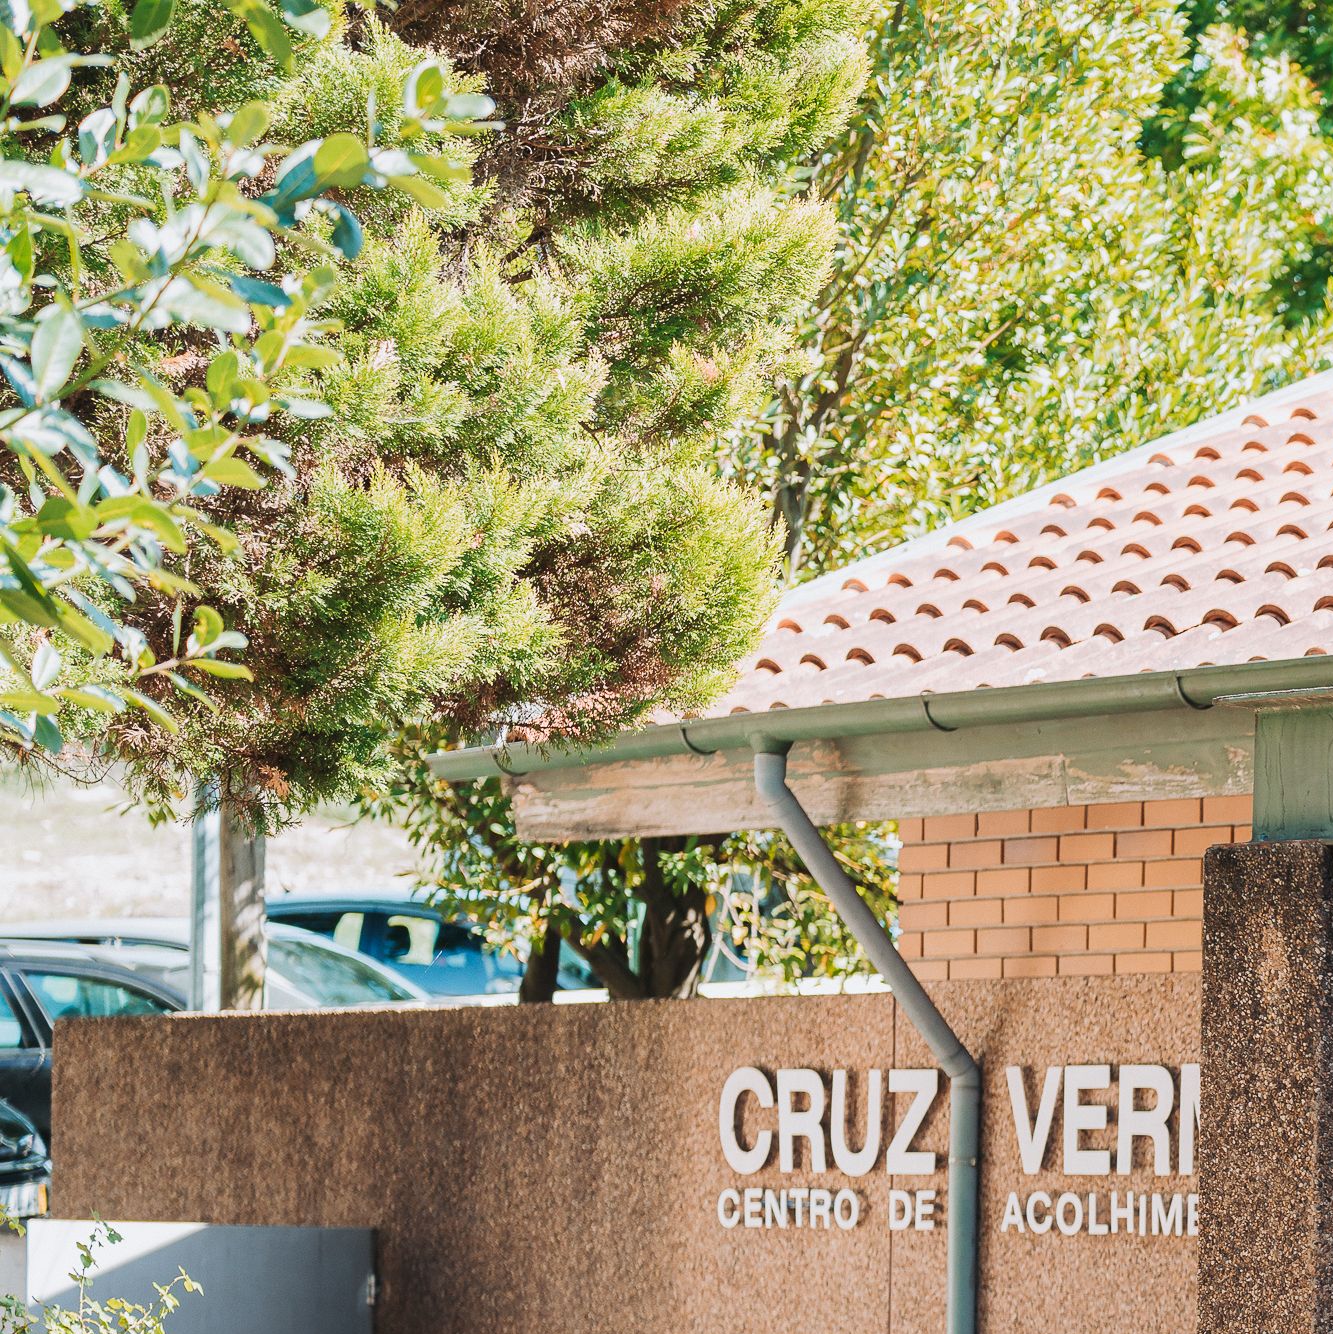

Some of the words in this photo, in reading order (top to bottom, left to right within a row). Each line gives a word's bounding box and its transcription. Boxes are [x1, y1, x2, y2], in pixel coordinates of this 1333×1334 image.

[718, 1066, 938, 1177] CRUZ
[717, 1187, 860, 1230] CENTRO
[888, 1189, 937, 1231] DE
